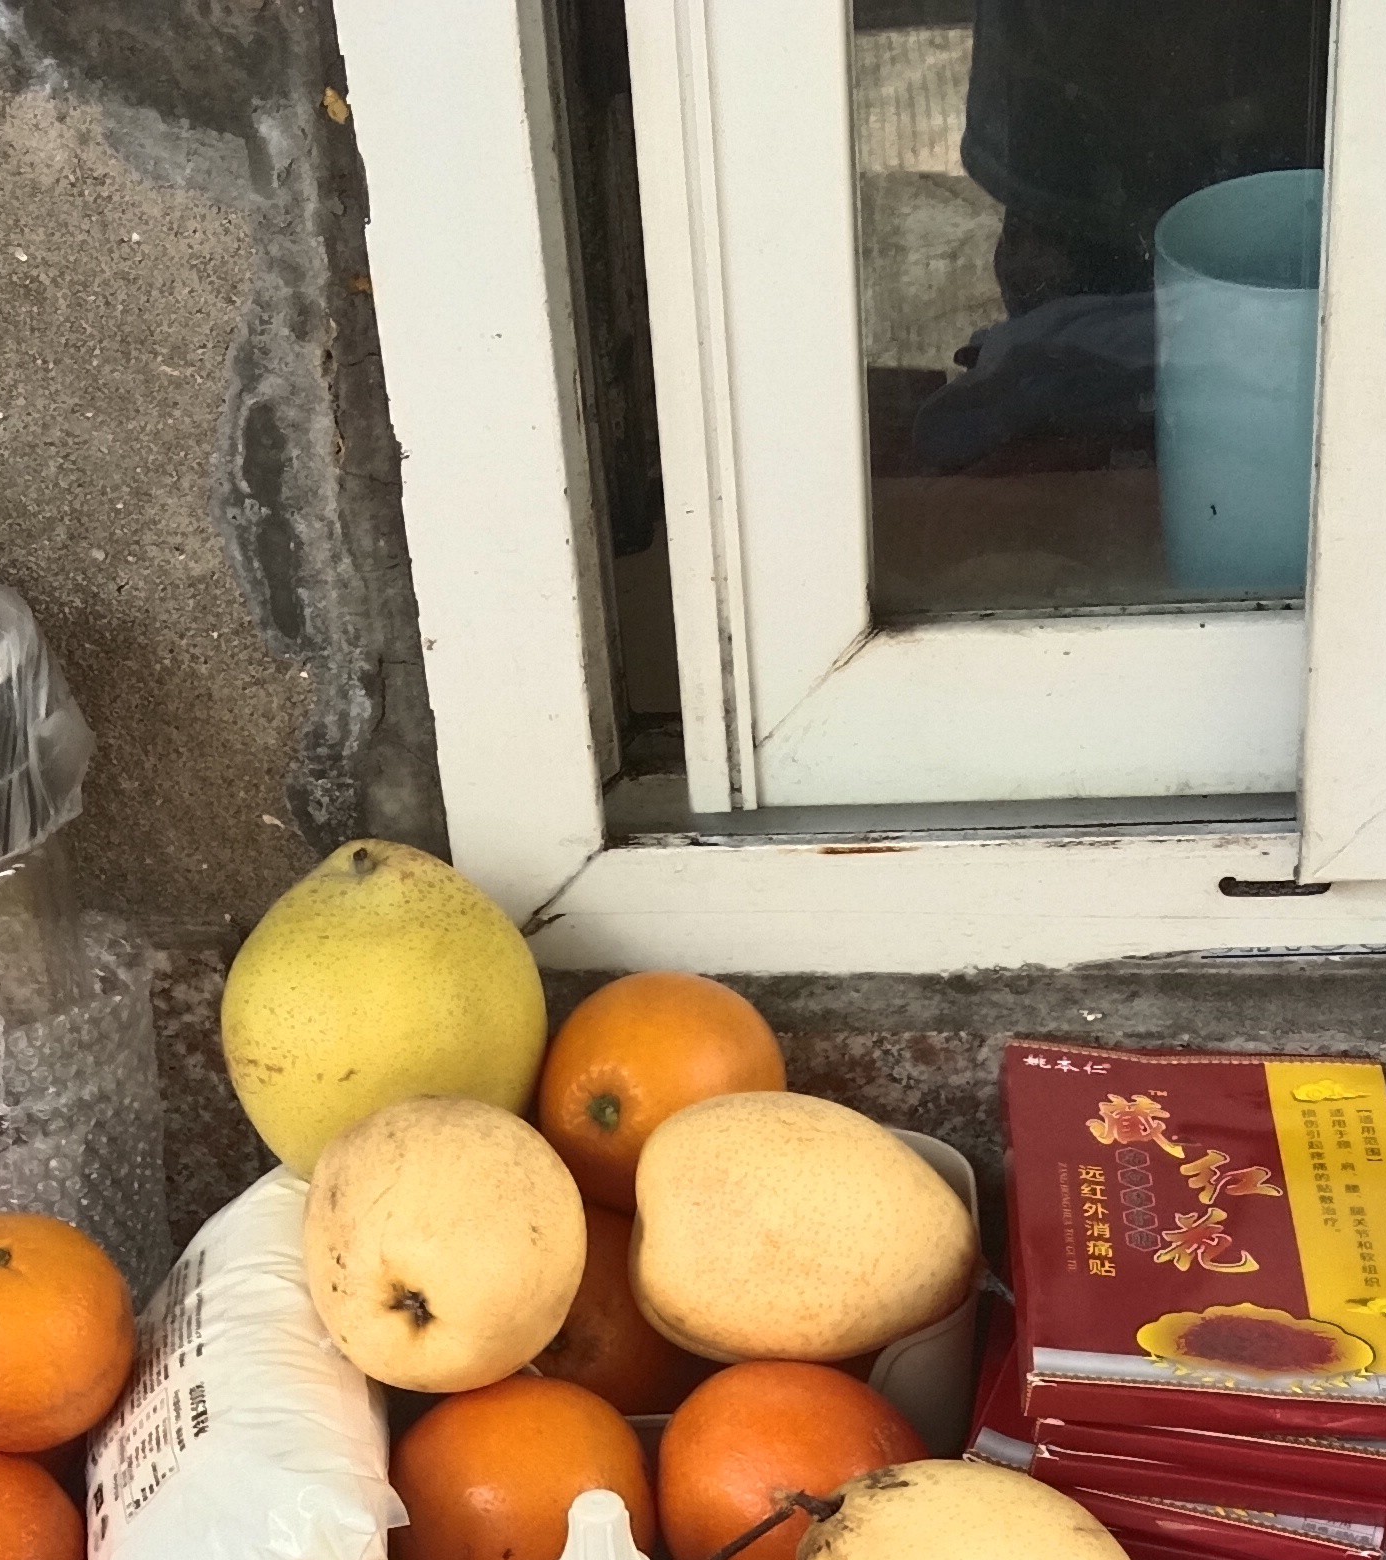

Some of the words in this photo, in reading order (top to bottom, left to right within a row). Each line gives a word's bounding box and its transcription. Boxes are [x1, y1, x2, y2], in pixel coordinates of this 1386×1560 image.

[1077, 1164, 1117, 1278] 远红外消痛贴
[1085, 1094, 1284, 1274] 藏红花
